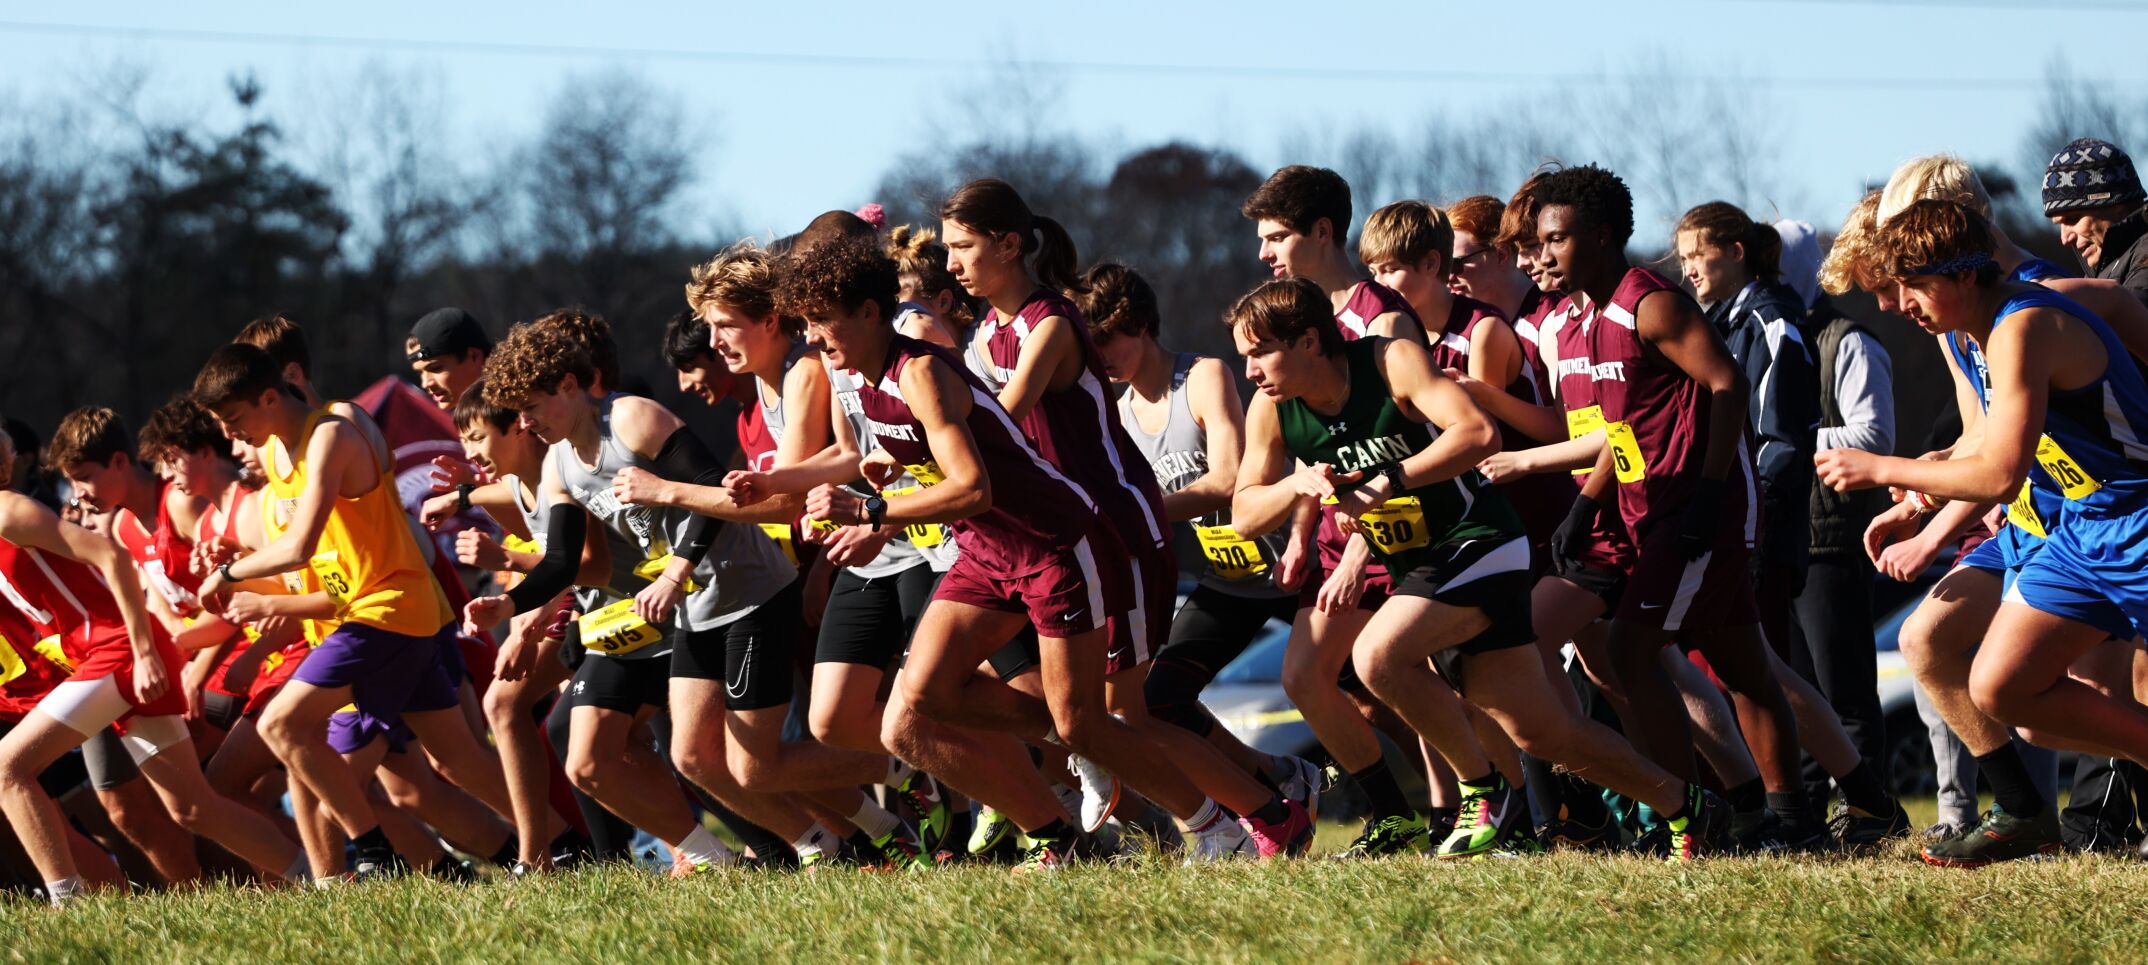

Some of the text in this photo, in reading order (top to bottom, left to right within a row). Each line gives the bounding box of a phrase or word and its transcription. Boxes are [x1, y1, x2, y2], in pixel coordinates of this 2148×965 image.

[1326, 433, 1413, 474] CANN
[1209, 545, 1251, 570] 370
[597, 623, 644, 650] 375
